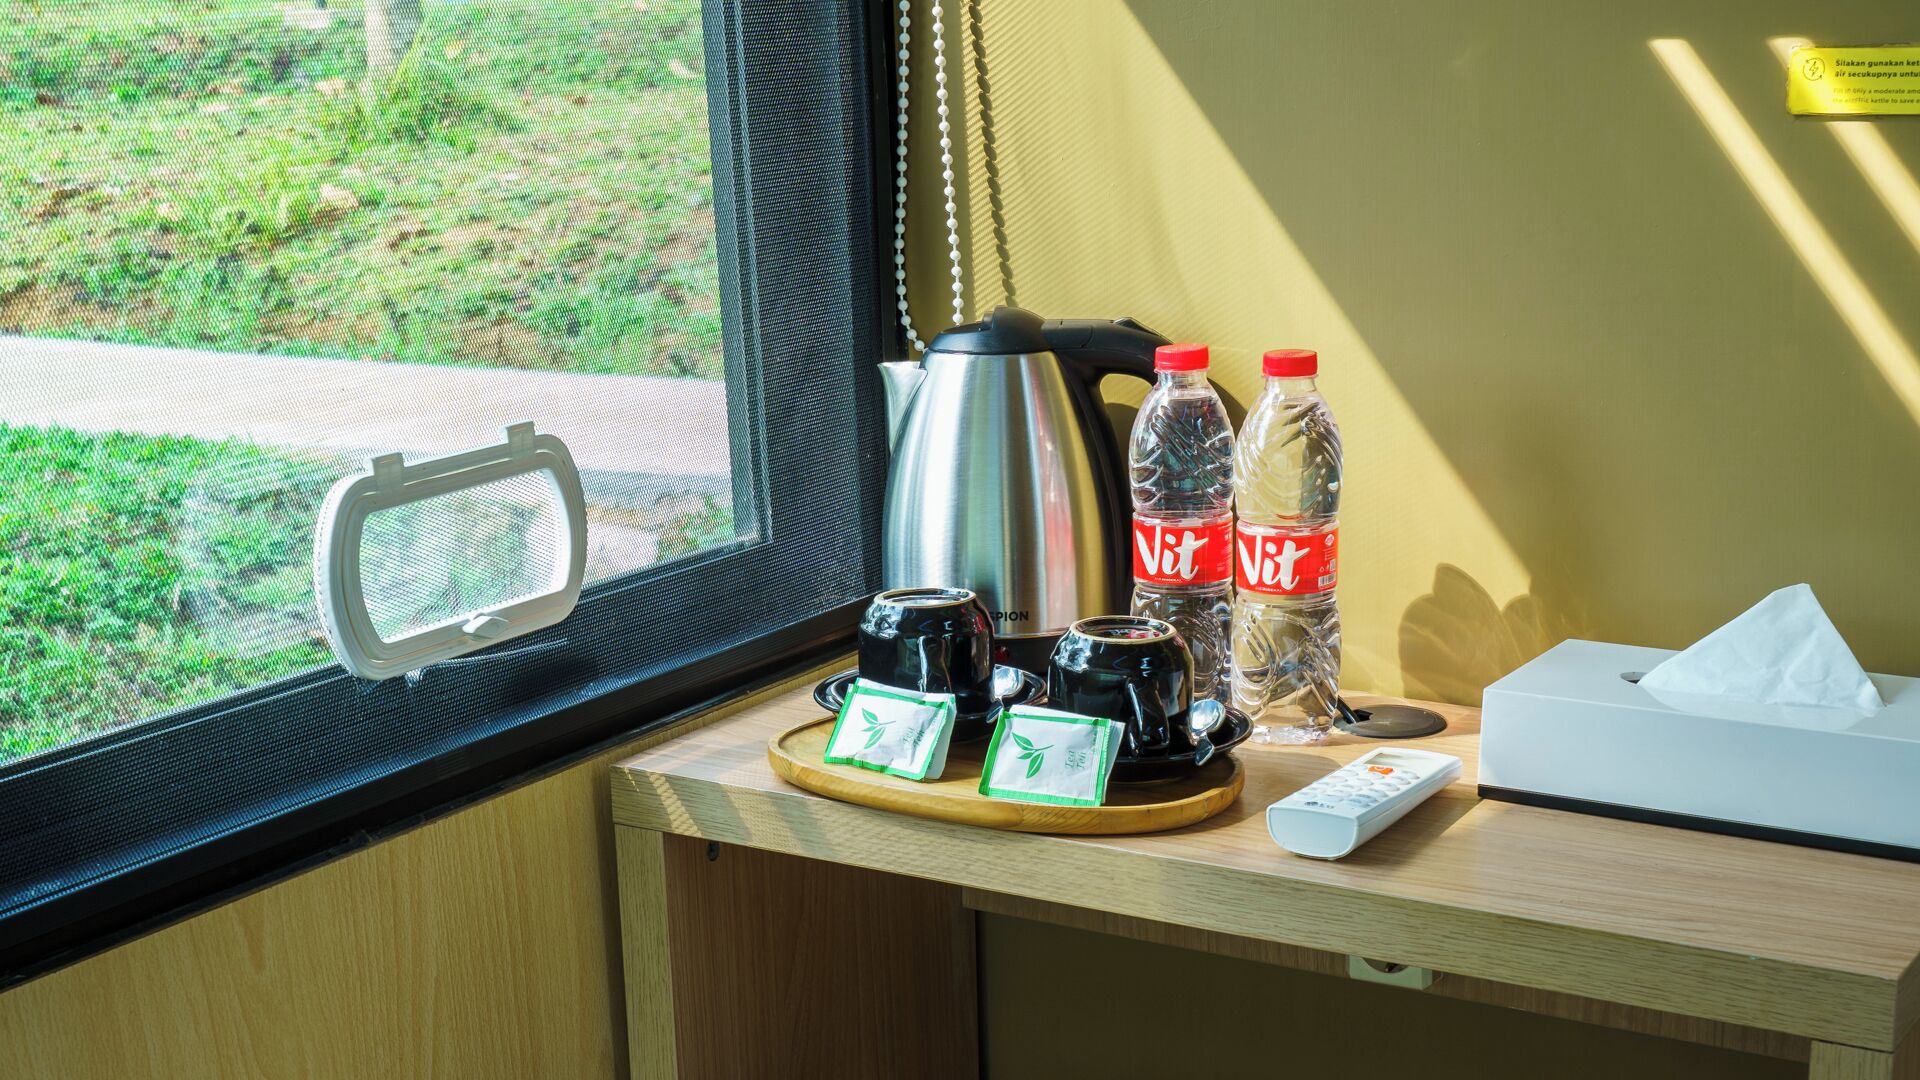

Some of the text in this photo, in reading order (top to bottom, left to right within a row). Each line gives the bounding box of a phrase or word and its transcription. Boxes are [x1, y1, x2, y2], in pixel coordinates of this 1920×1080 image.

[1836, 59, 1866, 67] Silakan
[1868, 60, 1904, 68] gunakan
[1848, 70, 1898, 79] secukupnya
[1135, 525, 1209, 580] Vit
[1237, 535, 1311, 591] Vit
[988, 610, 1030, 622] SPION
